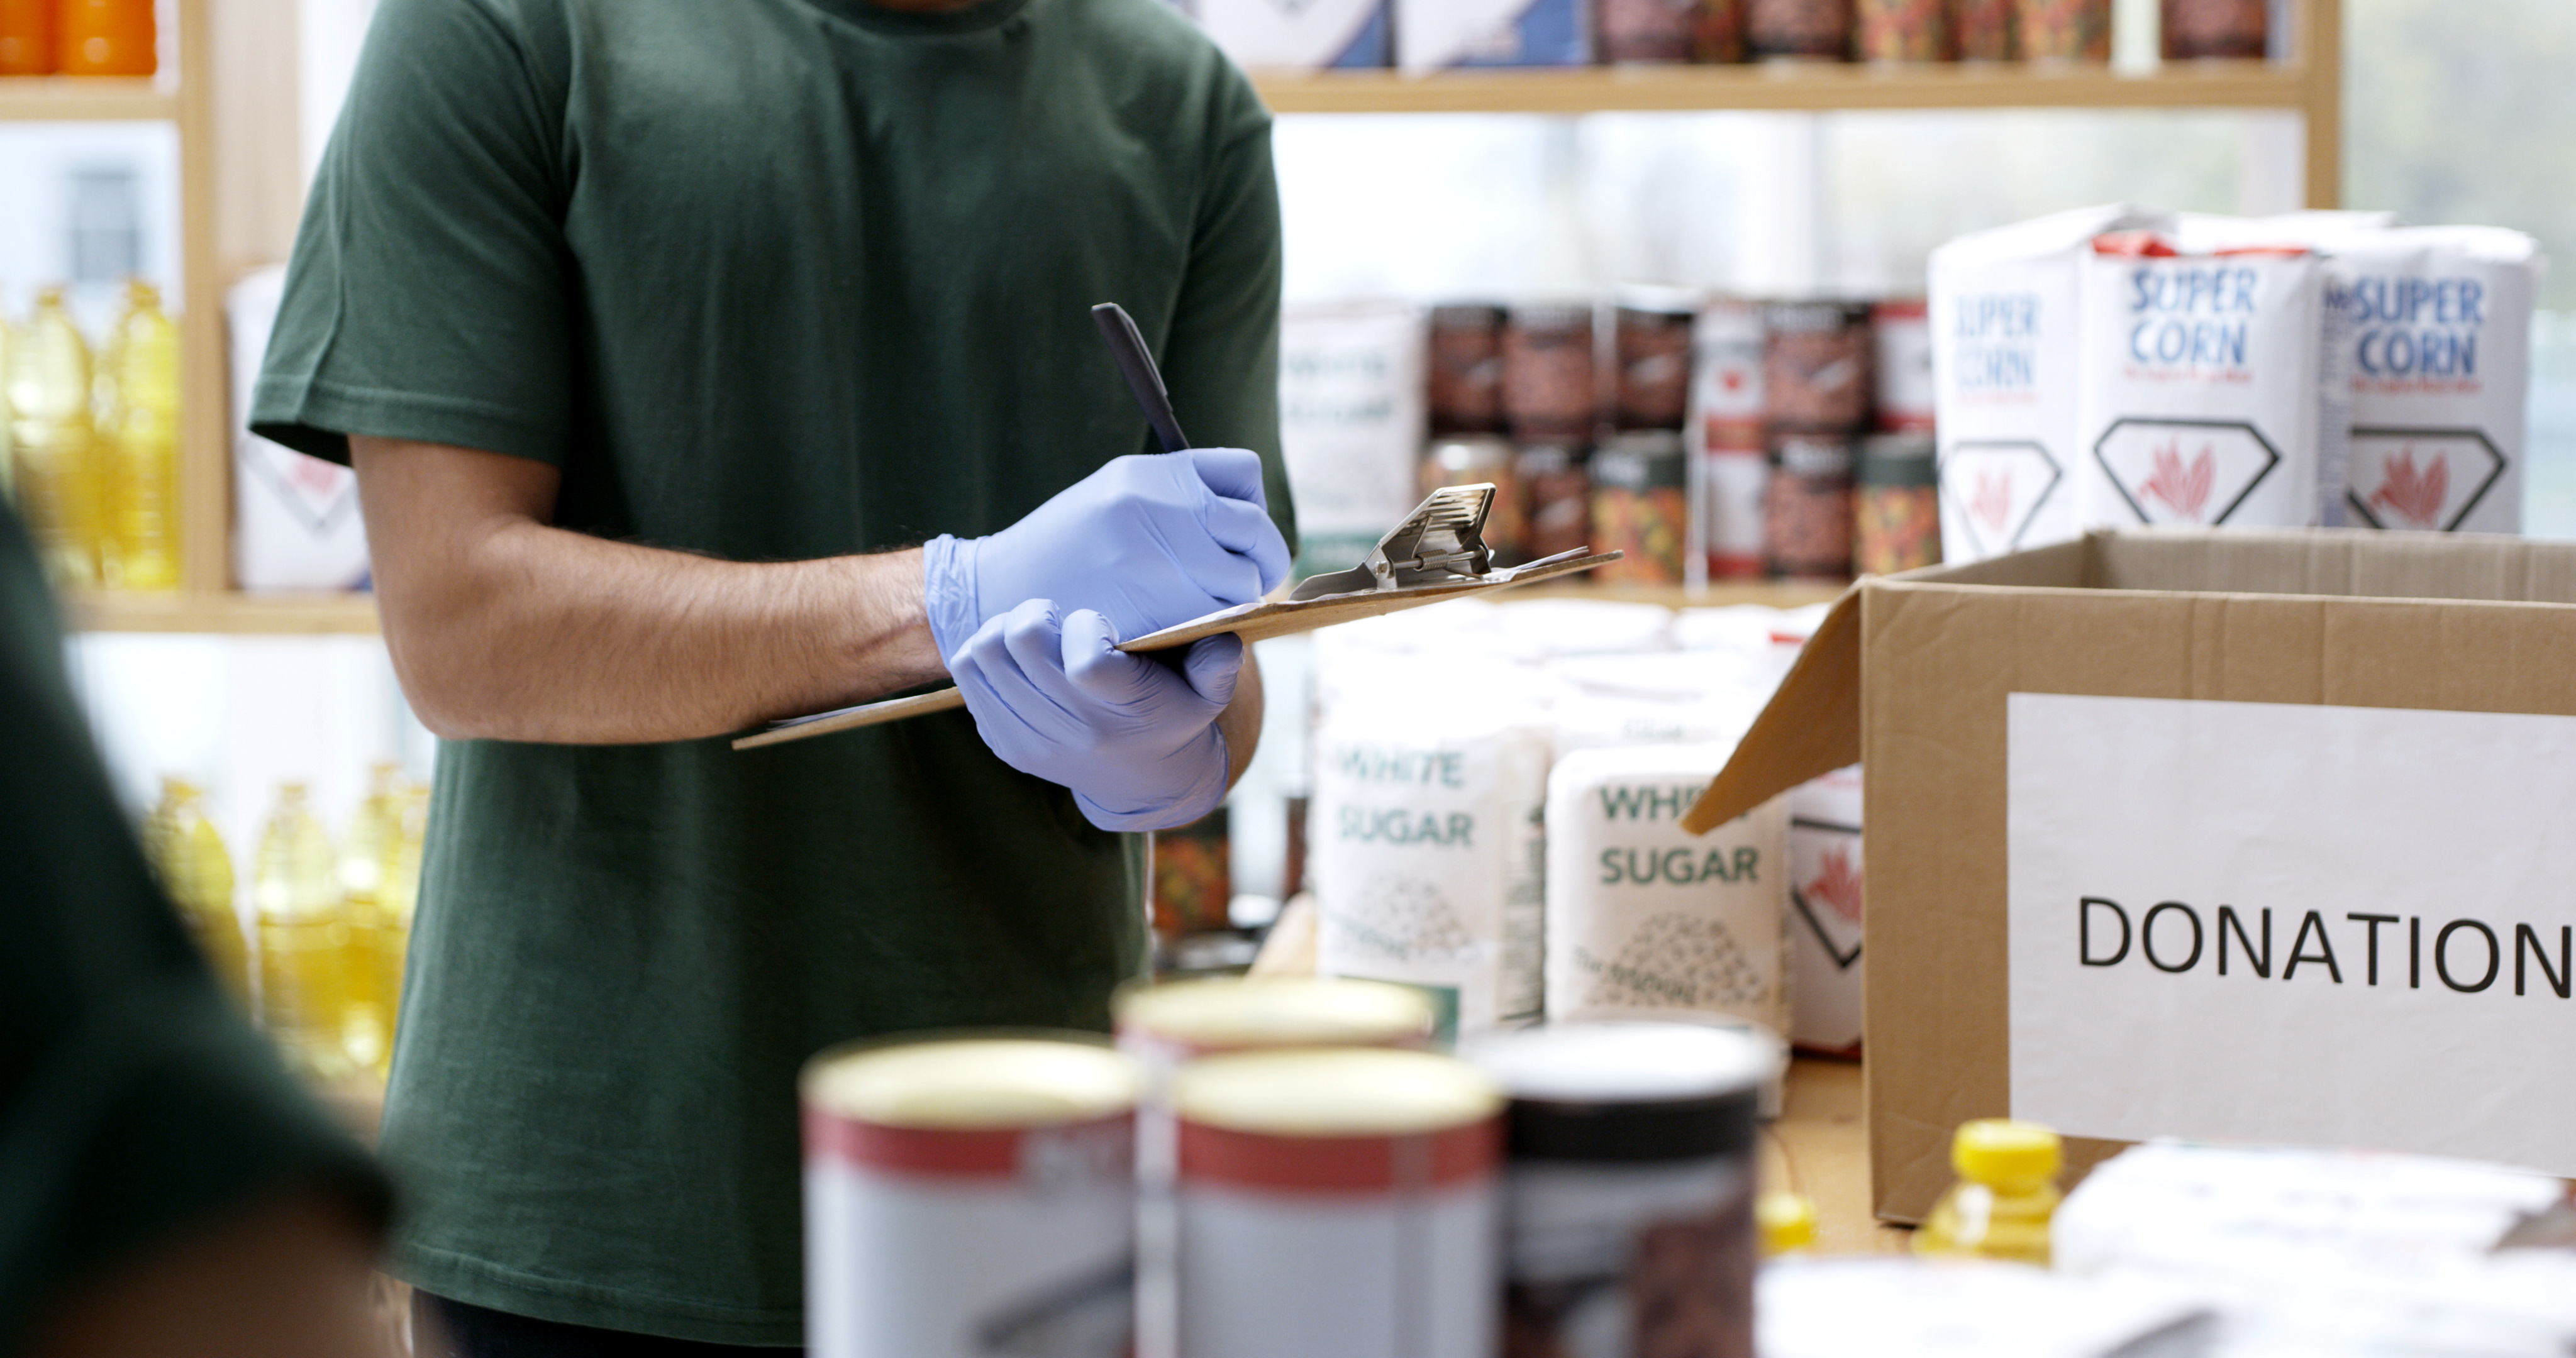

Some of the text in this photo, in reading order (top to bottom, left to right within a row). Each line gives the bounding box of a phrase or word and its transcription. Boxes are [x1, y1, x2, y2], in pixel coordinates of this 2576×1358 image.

[2133, 268, 2257, 312] SUPER
[2353, 278, 2484, 323] SUPER
[2131, 320, 2245, 365] CORN
[2358, 329, 2475, 376] CORN
[1338, 805, 1475, 847] SUGAR
[1600, 847, 1758, 883] SUGAR
